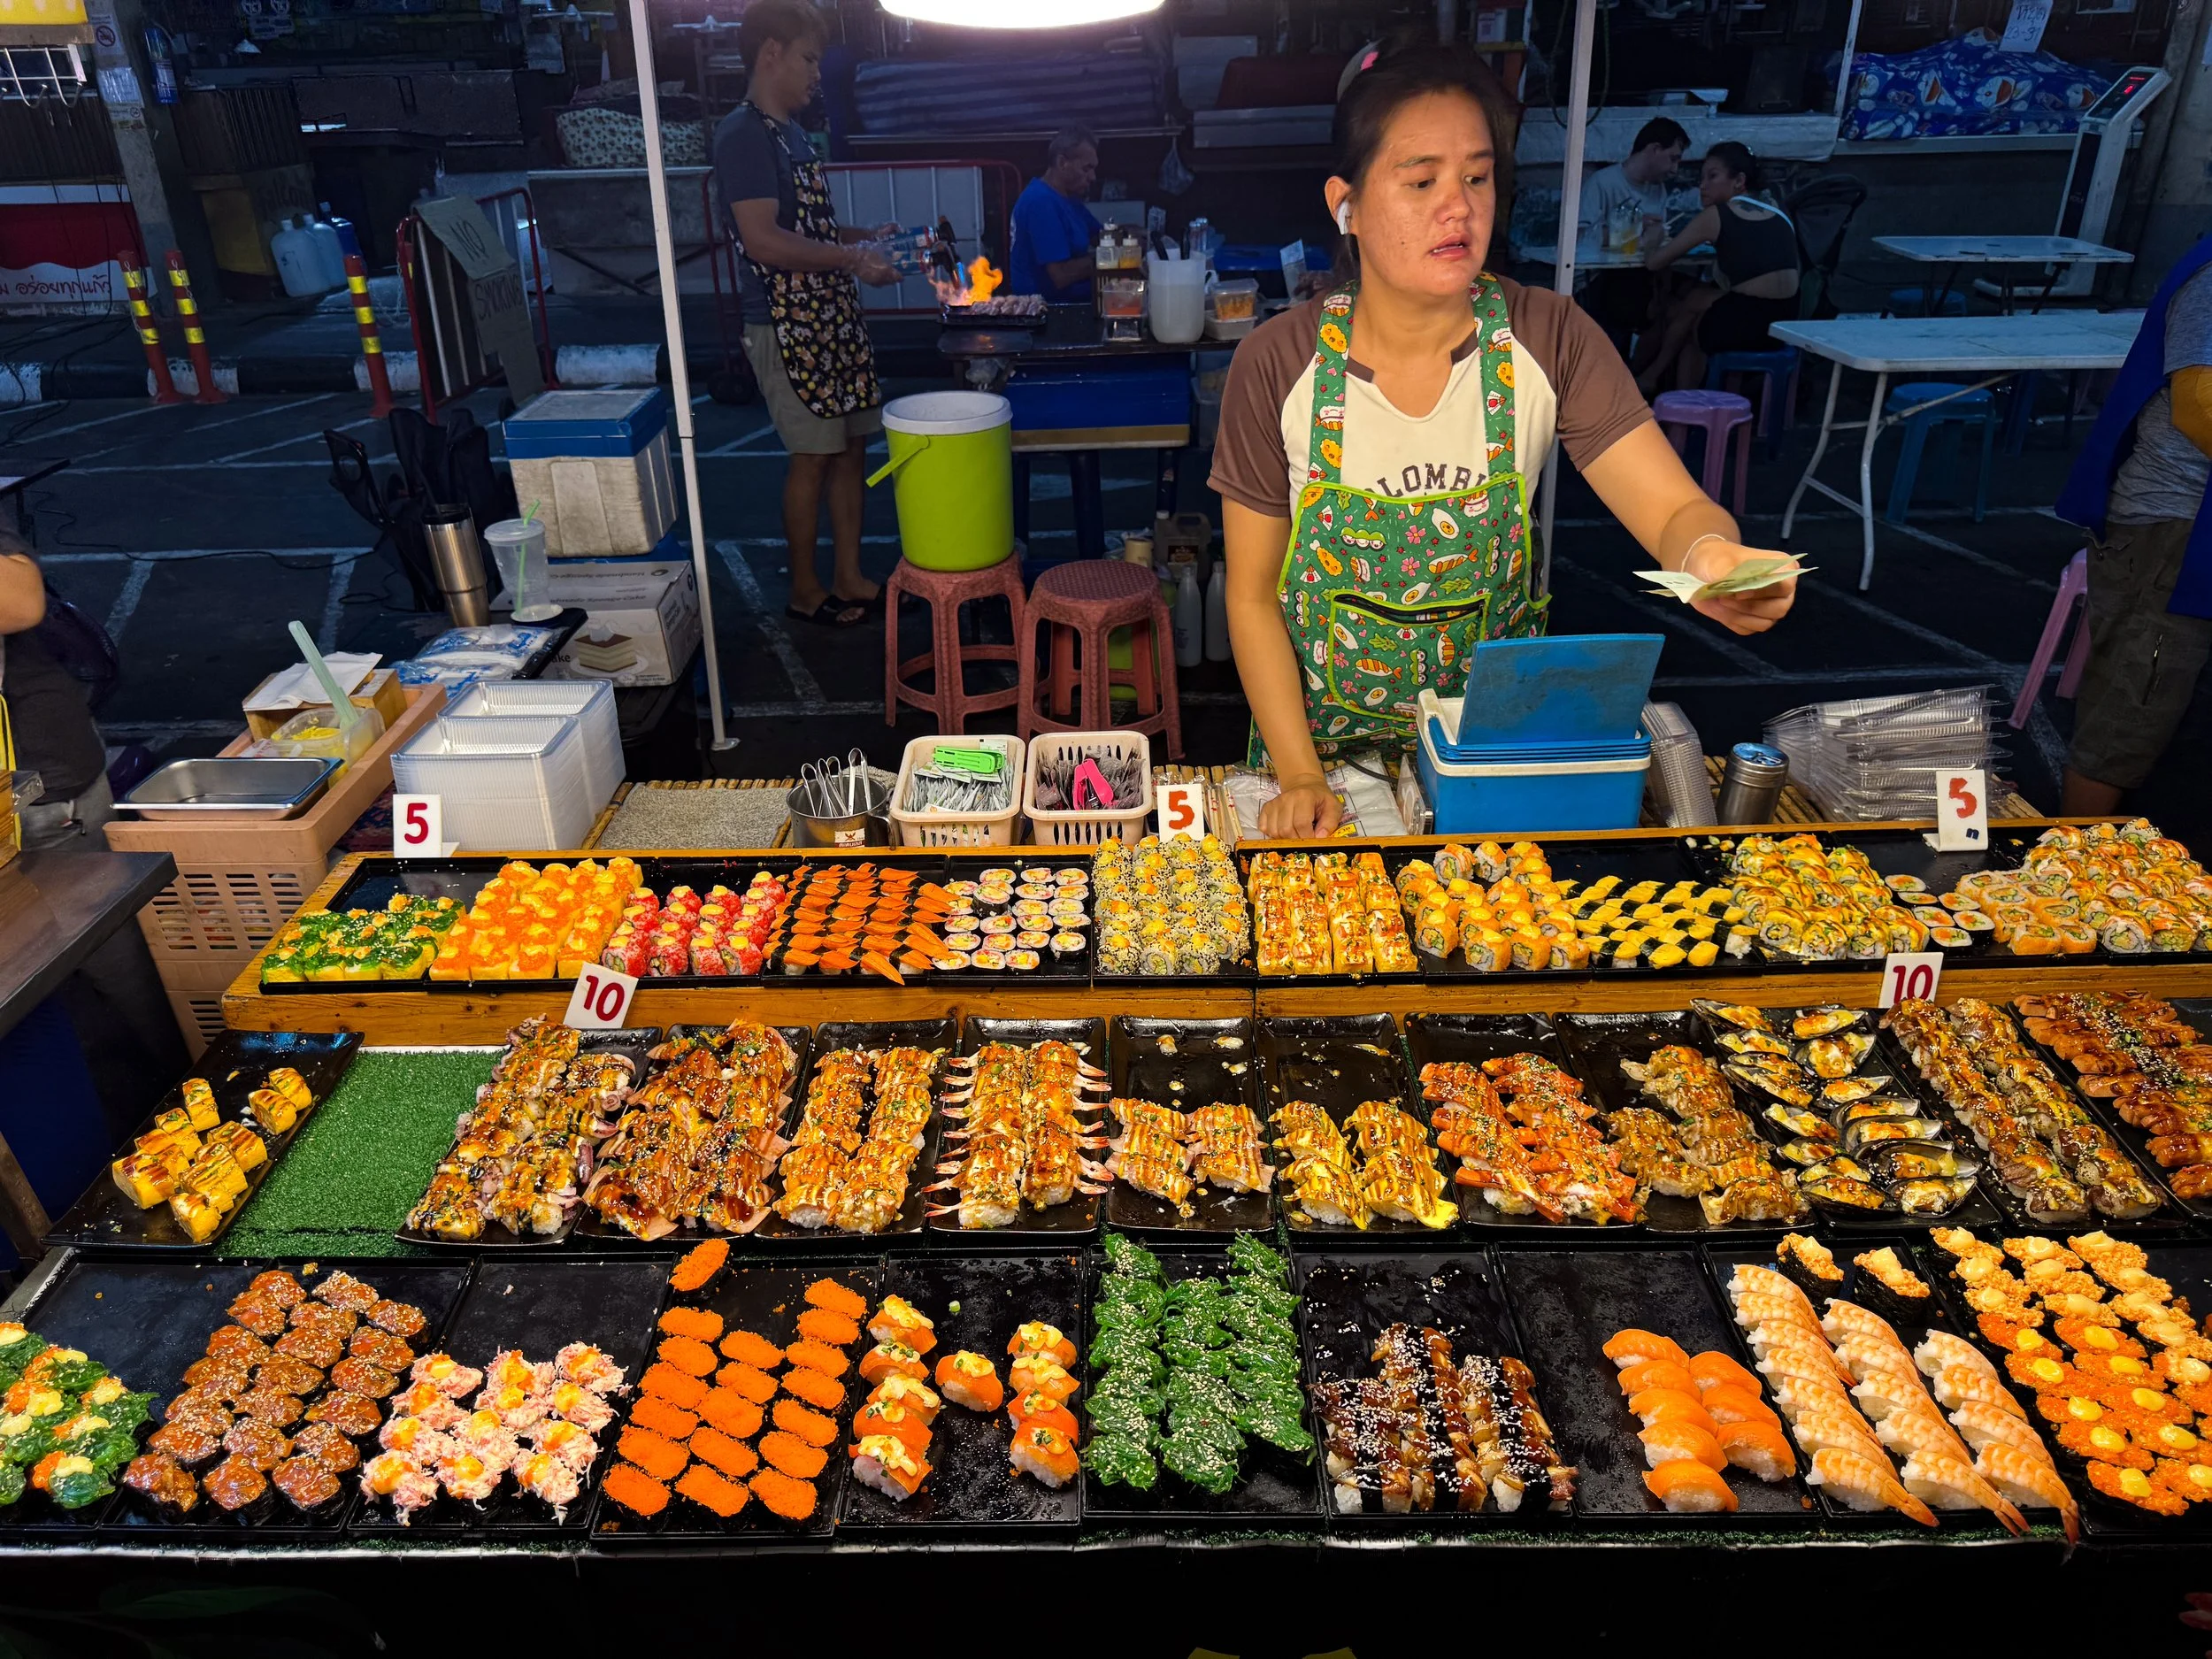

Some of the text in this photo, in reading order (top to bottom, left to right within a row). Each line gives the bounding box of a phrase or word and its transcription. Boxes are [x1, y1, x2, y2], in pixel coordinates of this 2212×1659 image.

[449, 219, 490, 262] NO
[551, 654, 571, 663] ake
[1169, 790, 1194, 830] 5
[1949, 778, 1978, 818] 5
[404, 803, 428, 844] 5
[584, 975, 626, 1021] 10
[1893, 964, 1933, 1005] 10
